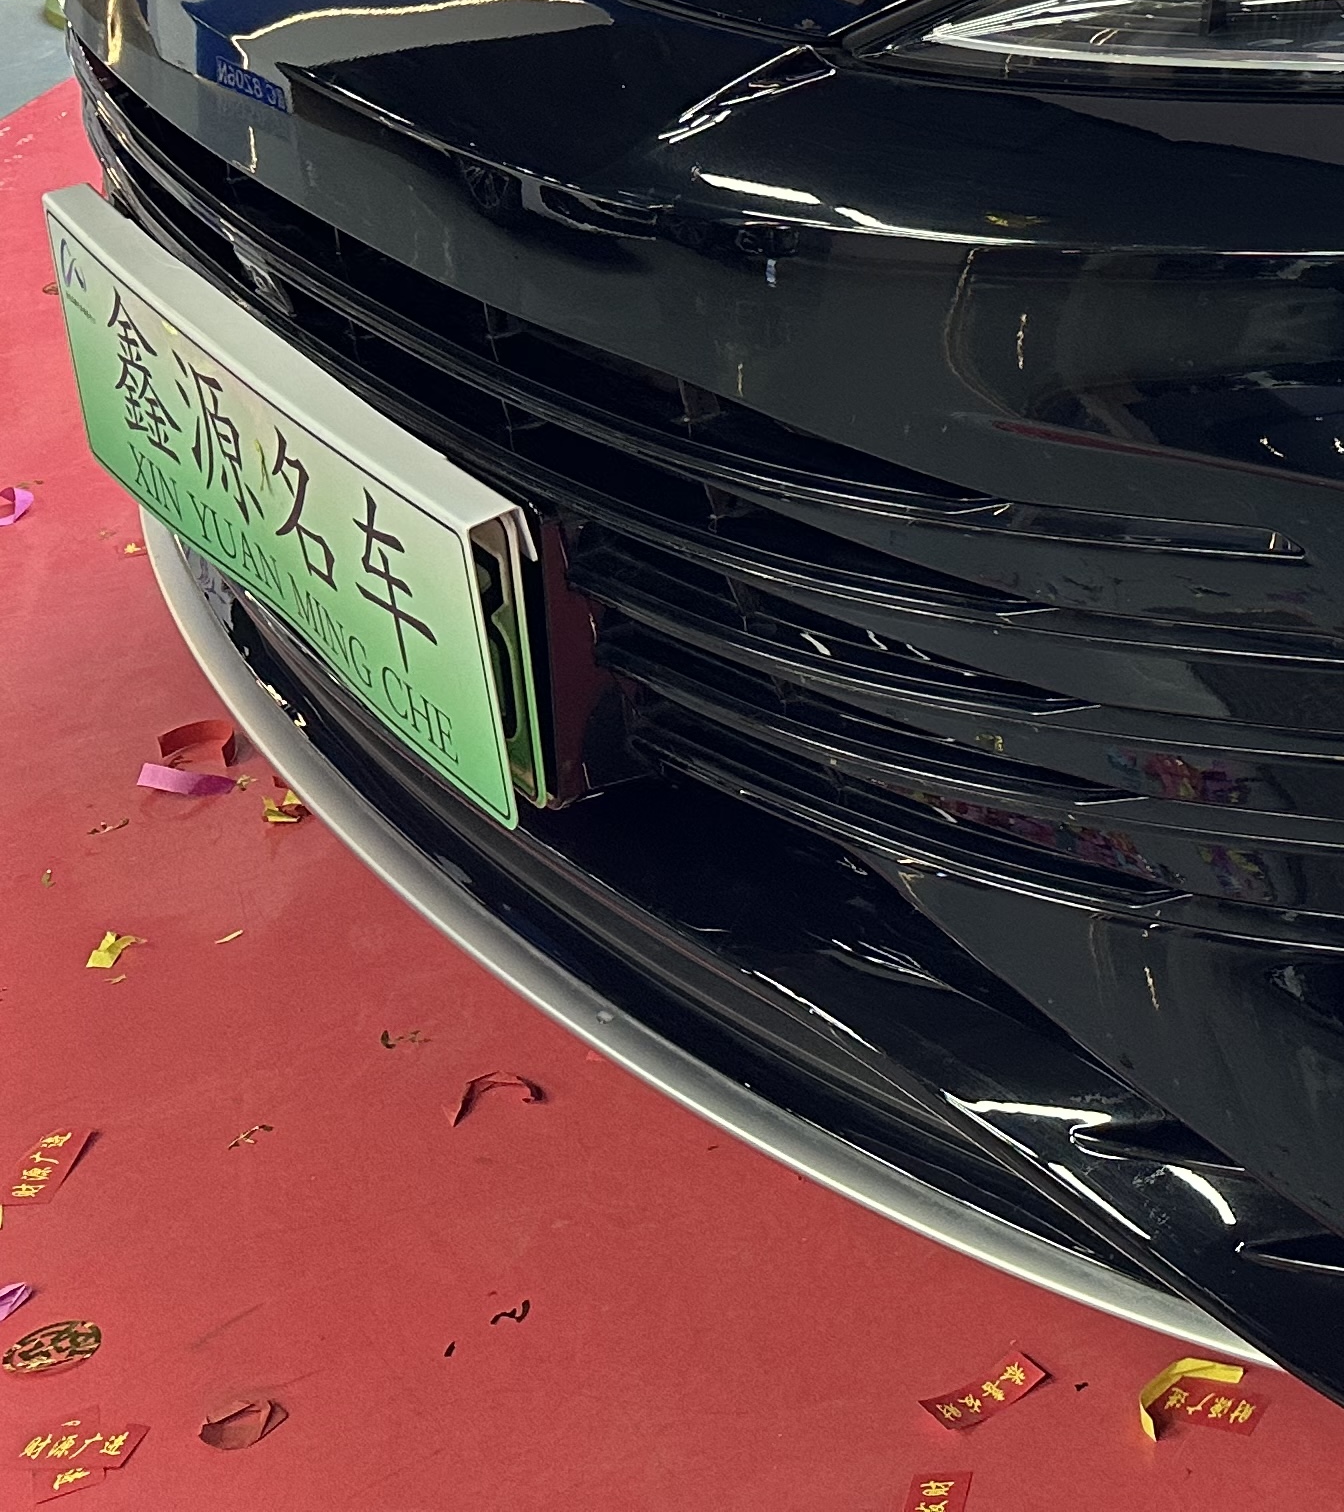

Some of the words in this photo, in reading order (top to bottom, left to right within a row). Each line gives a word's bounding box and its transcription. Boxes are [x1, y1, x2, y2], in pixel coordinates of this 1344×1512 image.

[107, 286, 438, 672] 鑫源名车
[128, 441, 184, 524] XIN
[192, 510, 286, 602] YUAN
[291, 571, 373, 684] MING
[380, 664, 460, 766] CHE
[936, 1360, 1027, 1421] 恭喜发财
[1163, 1386, 1257, 1424] 财源广进
[19, 1430, 130, 1460] 财源广进
